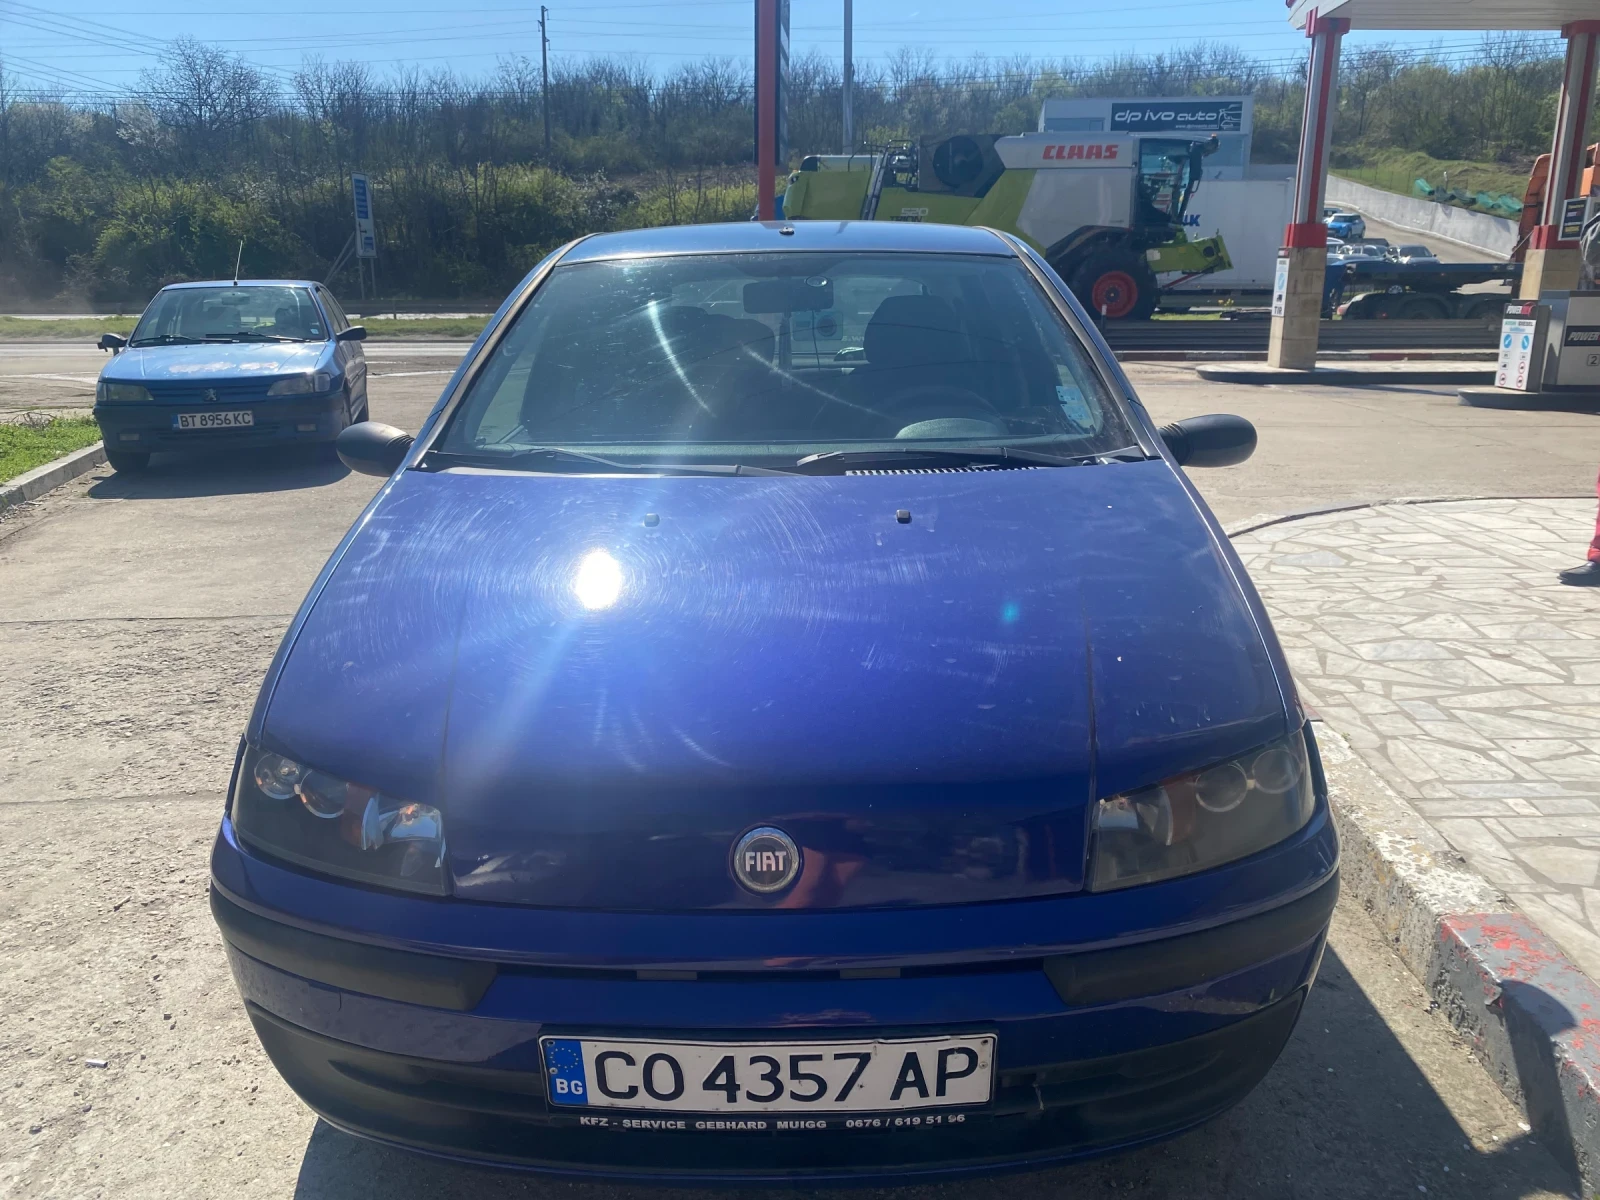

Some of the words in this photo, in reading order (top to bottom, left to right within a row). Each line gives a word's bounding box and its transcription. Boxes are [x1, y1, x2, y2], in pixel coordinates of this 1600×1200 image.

[1115, 110, 1142, 123] dp
[1144, 109, 1175, 121] ivo
[1177, 111, 1217, 121] auto
[1042, 145, 1119, 160] CLAAS
[1590, 355, 1598, 365] 2
[180, 415, 196, 427] BT
[200, 413, 231, 426] 8956
[233, 412, 251, 425] KC
[745, 851, 787, 872] FIAT
[595, 1051, 685, 1101] CO
[702, 1052, 872, 1103] 4357
[890, 1046, 979, 1100] AP
[555, 1078, 583, 1095] BG
[580, 1116, 609, 1127] KFZ
[622, 1119, 686, 1130] SERVICE
[695, 1121, 767, 1130] GEBHARD
[776, 1120, 827, 1130] MUIGG
[845, 1118, 881, 1129] 0676
[894, 1116, 921, 1126] 619
[926, 1115, 942, 1125] 51
[947, 1114, 966, 1123] 96
